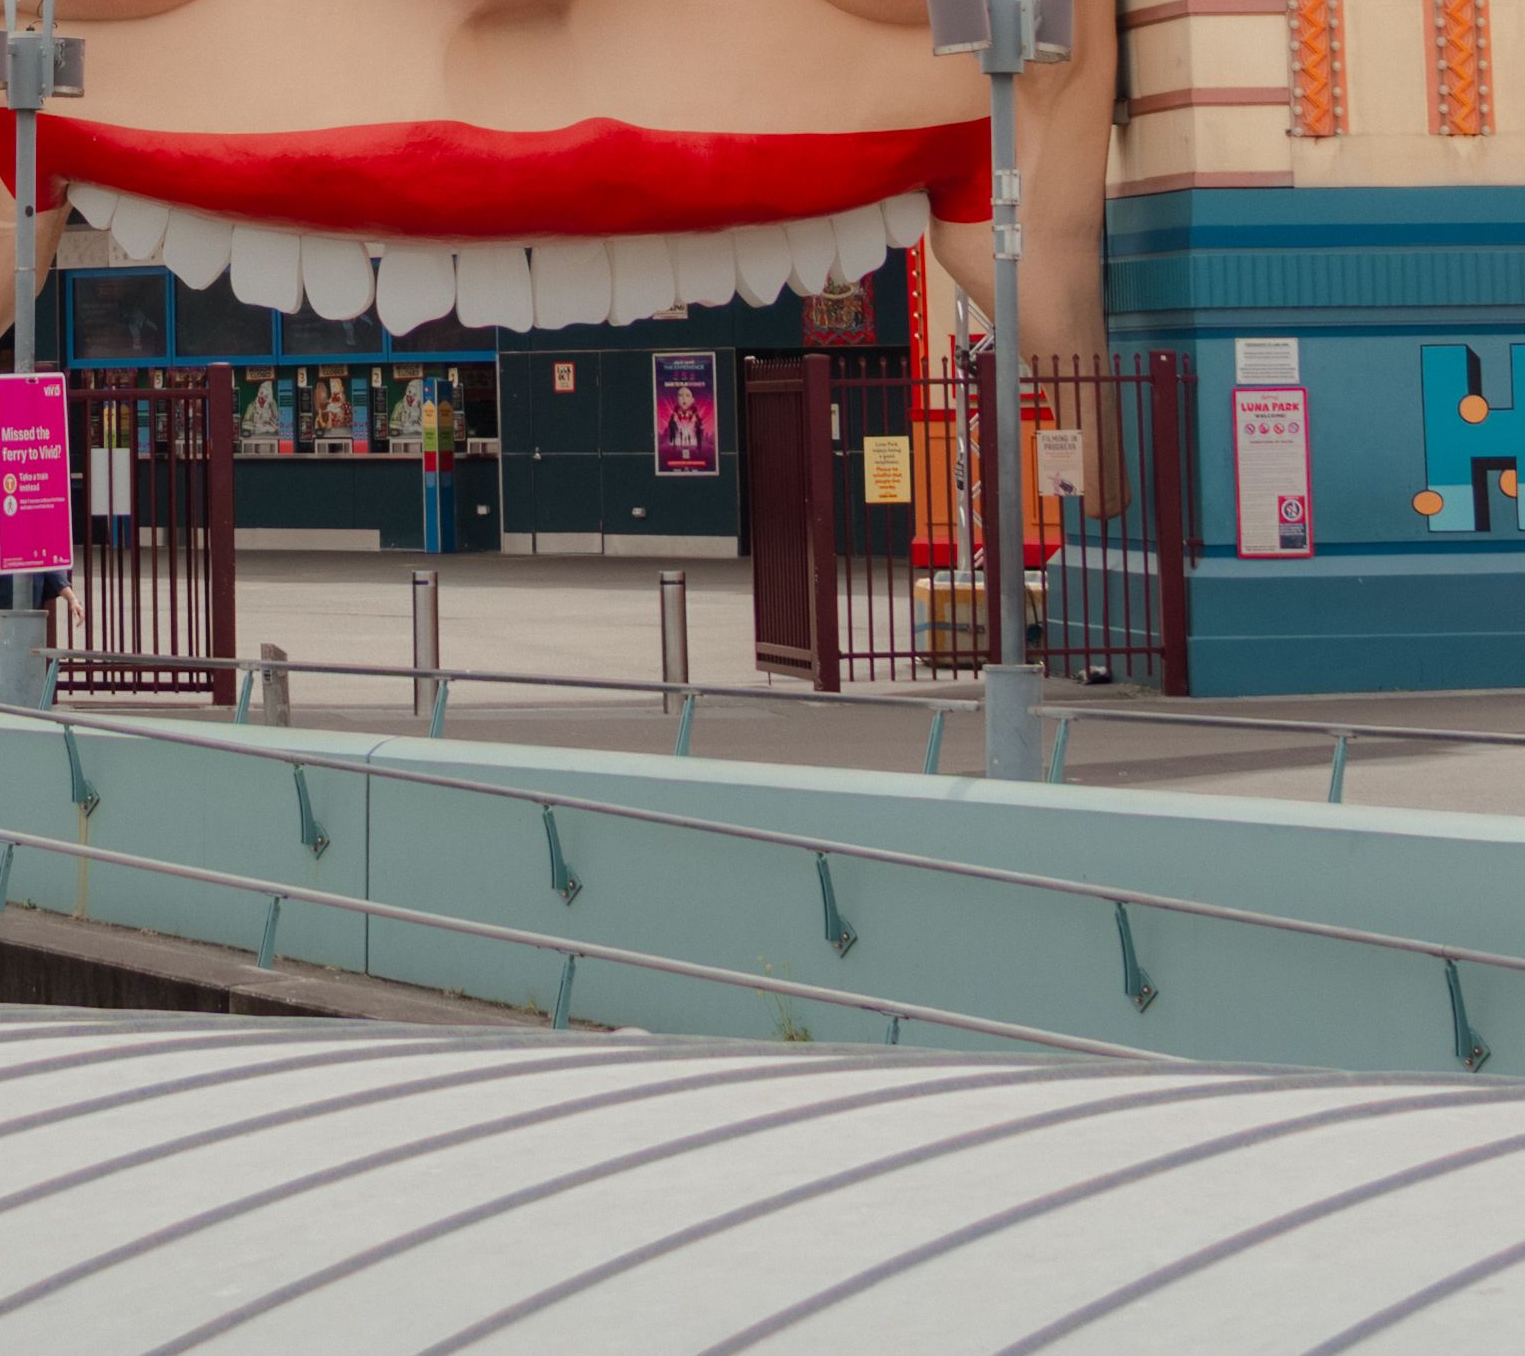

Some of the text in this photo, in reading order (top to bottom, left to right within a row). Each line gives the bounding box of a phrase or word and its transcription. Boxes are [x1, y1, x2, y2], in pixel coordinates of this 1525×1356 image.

[1241, 402, 1299, 412] LUNA PARK
[1, 425, 50, 441] Missed the
[2, 445, 61, 464] ferry to Vivid?
